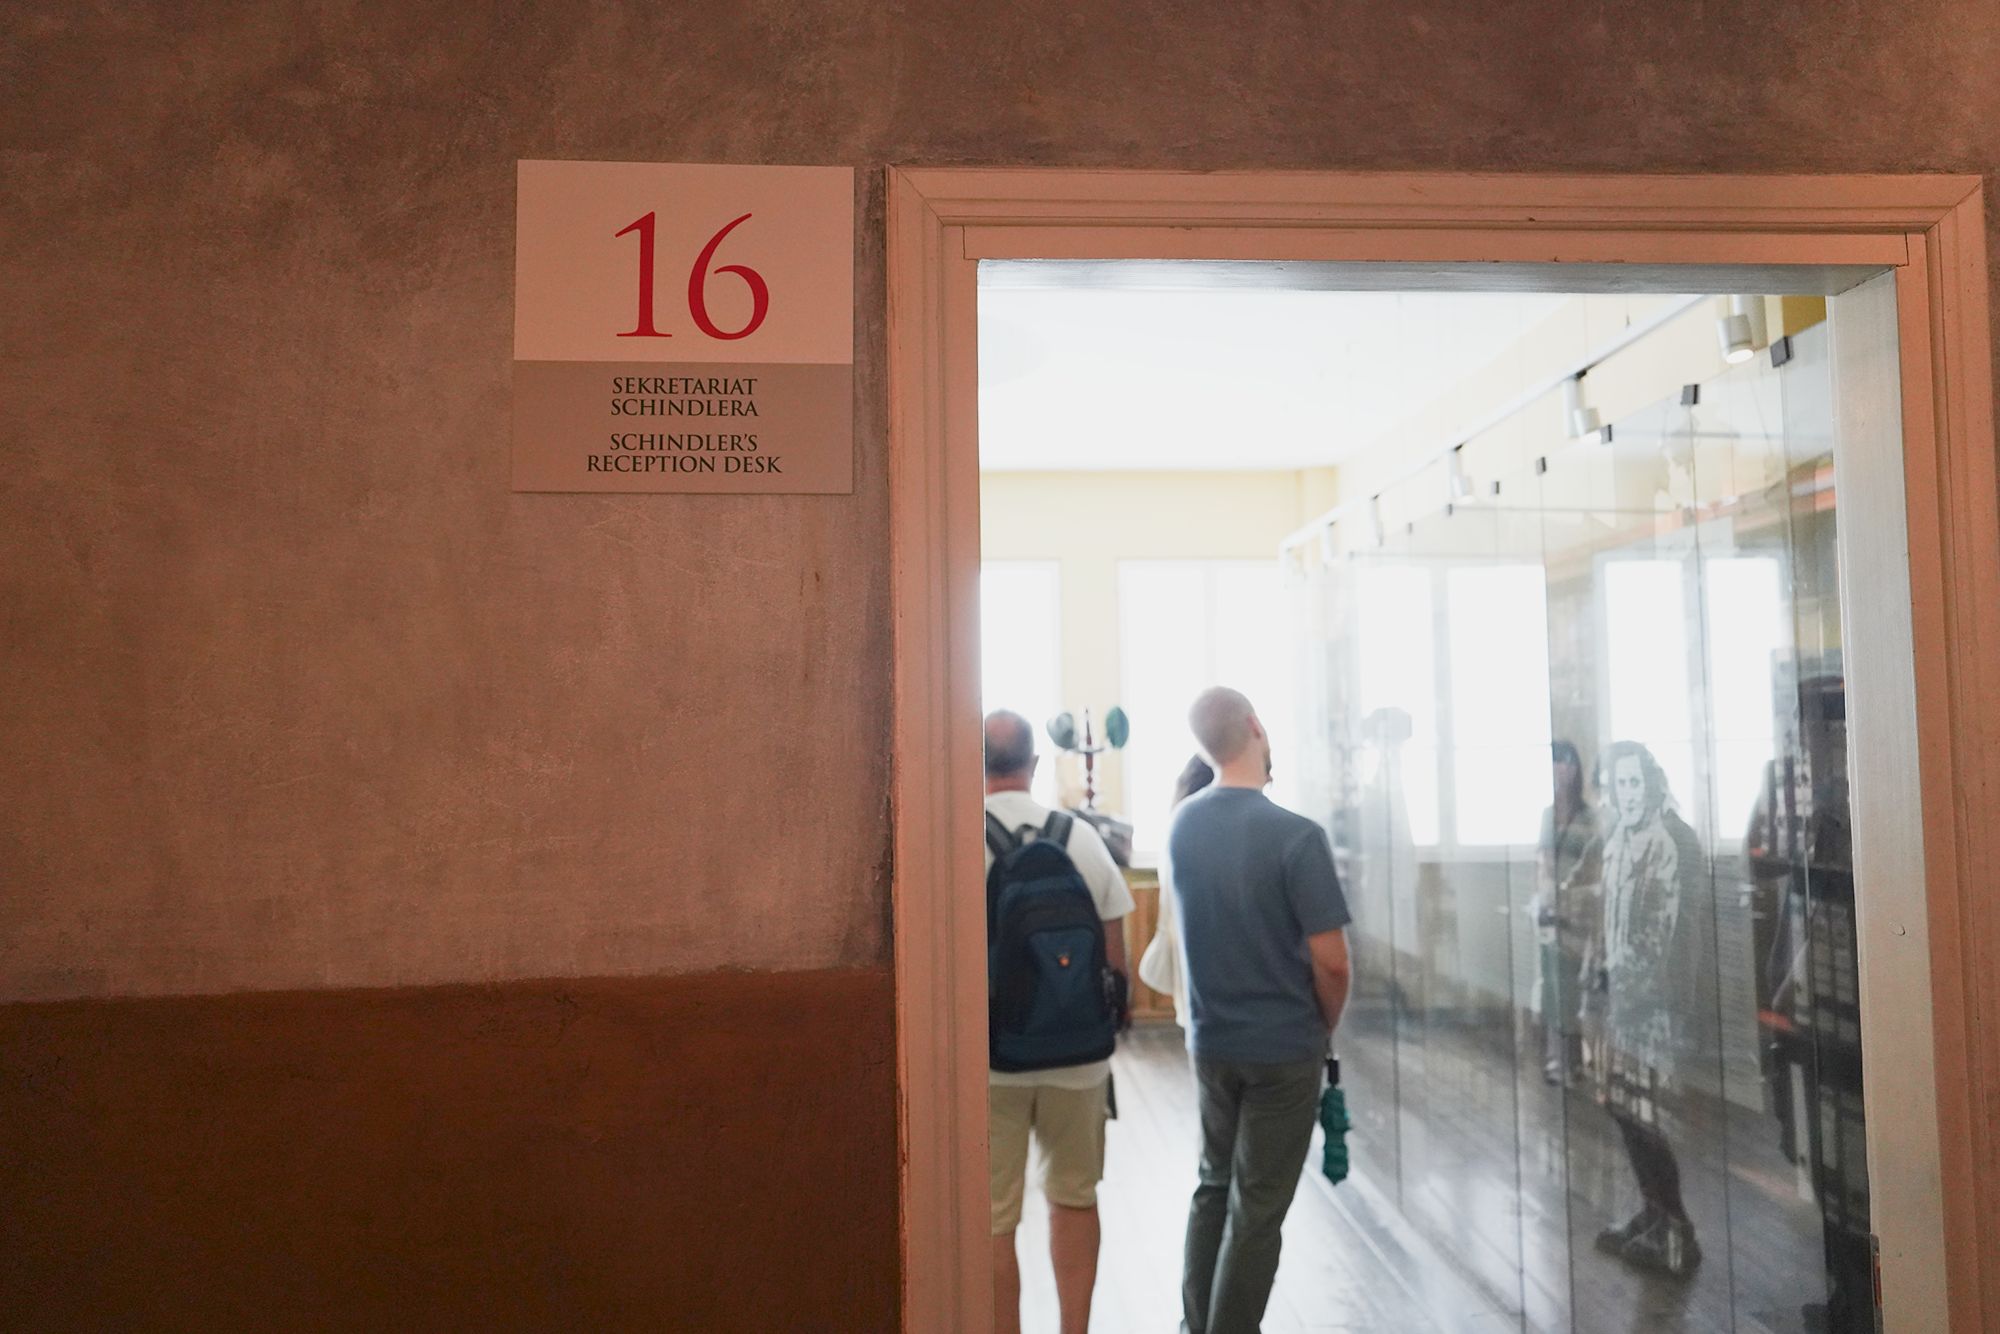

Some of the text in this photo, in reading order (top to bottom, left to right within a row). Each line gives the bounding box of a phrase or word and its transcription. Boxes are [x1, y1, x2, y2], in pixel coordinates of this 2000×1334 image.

[614, 211, 769, 340] 16
[612, 377, 758, 395] SEKRETARIAT
[610, 399, 759, 417] SCHINDLERA
[609, 433, 758, 452] SCHINDLER'S
[586, 455, 782, 474] RECEPTION DESK
